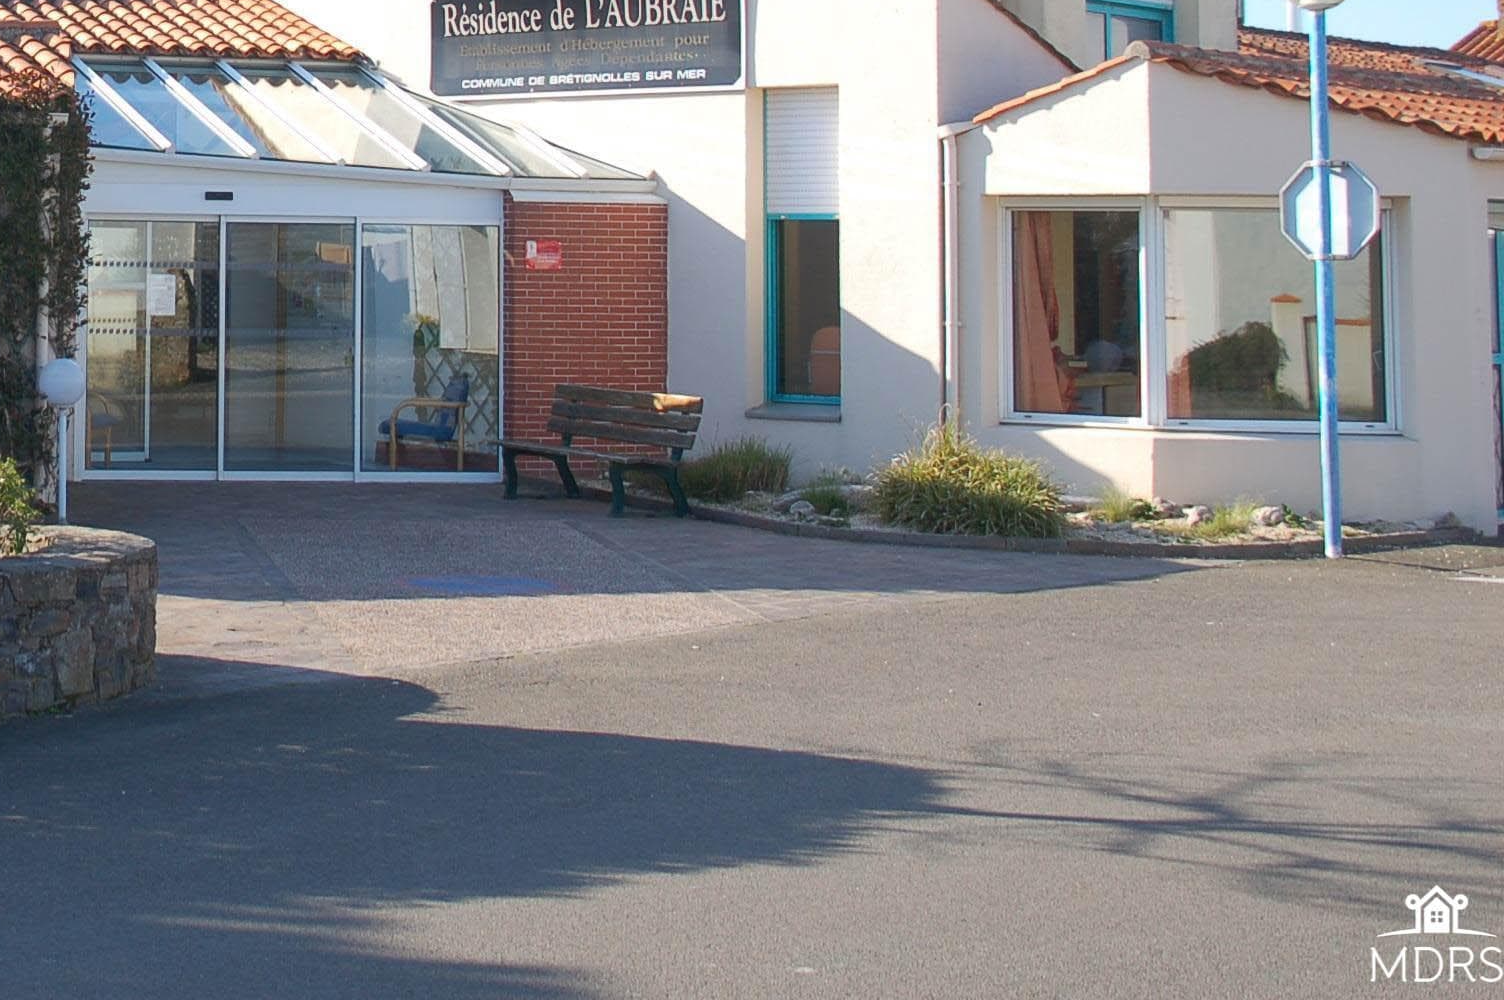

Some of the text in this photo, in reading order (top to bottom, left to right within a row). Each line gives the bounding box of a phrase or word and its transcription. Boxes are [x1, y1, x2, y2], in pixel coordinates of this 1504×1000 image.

[441, 0, 542, 38] Résidence
[674, 33, 710, 49] pour
[461, 69, 707, 89] COMMUNE DE BRÉTIGNOLLES SUR MER
